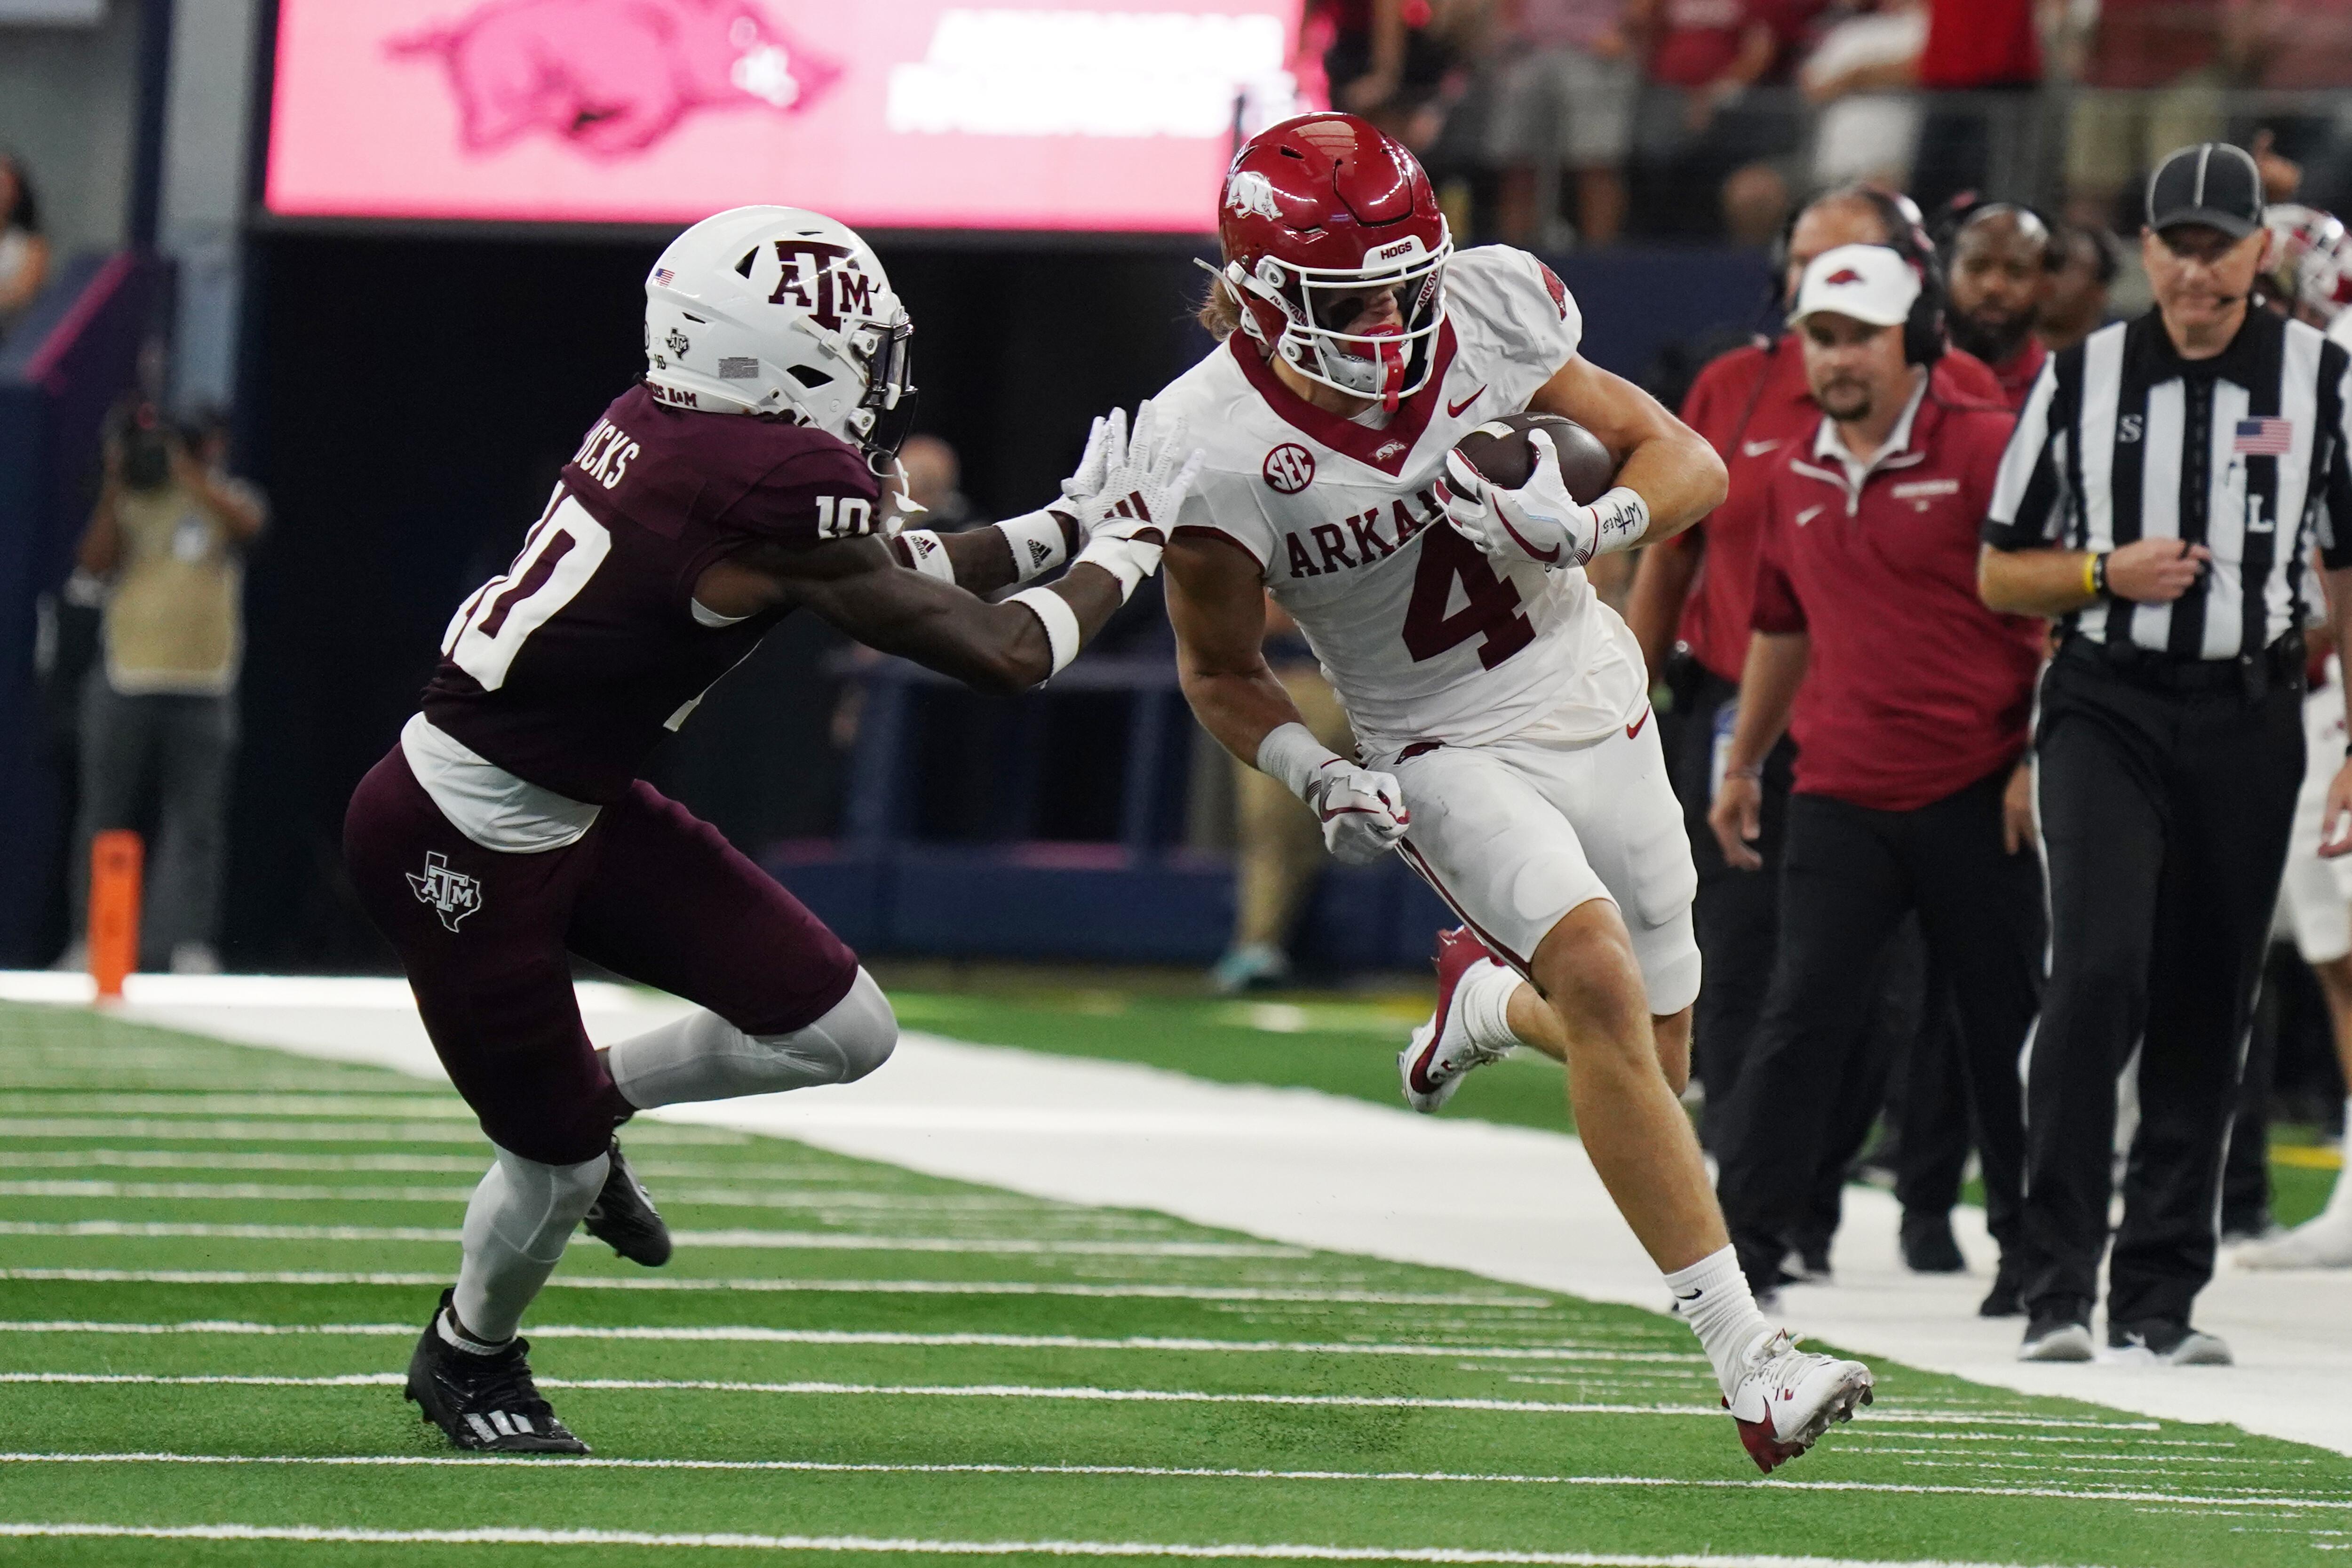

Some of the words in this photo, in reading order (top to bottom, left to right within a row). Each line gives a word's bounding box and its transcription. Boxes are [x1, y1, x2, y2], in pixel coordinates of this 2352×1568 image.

[1381, 241, 1412, 260] HOGS
[2118, 414, 2142, 444] S
[572, 418, 640, 490] ICKS
[1265, 445, 1312, 492] SEC
[816, 495, 871, 540] 10
[2248, 493, 2274, 533] L
[910, 535, 929, 560] adidas
[1027, 539, 1041, 569] adidas
[1401, 513, 1537, 672] 4
